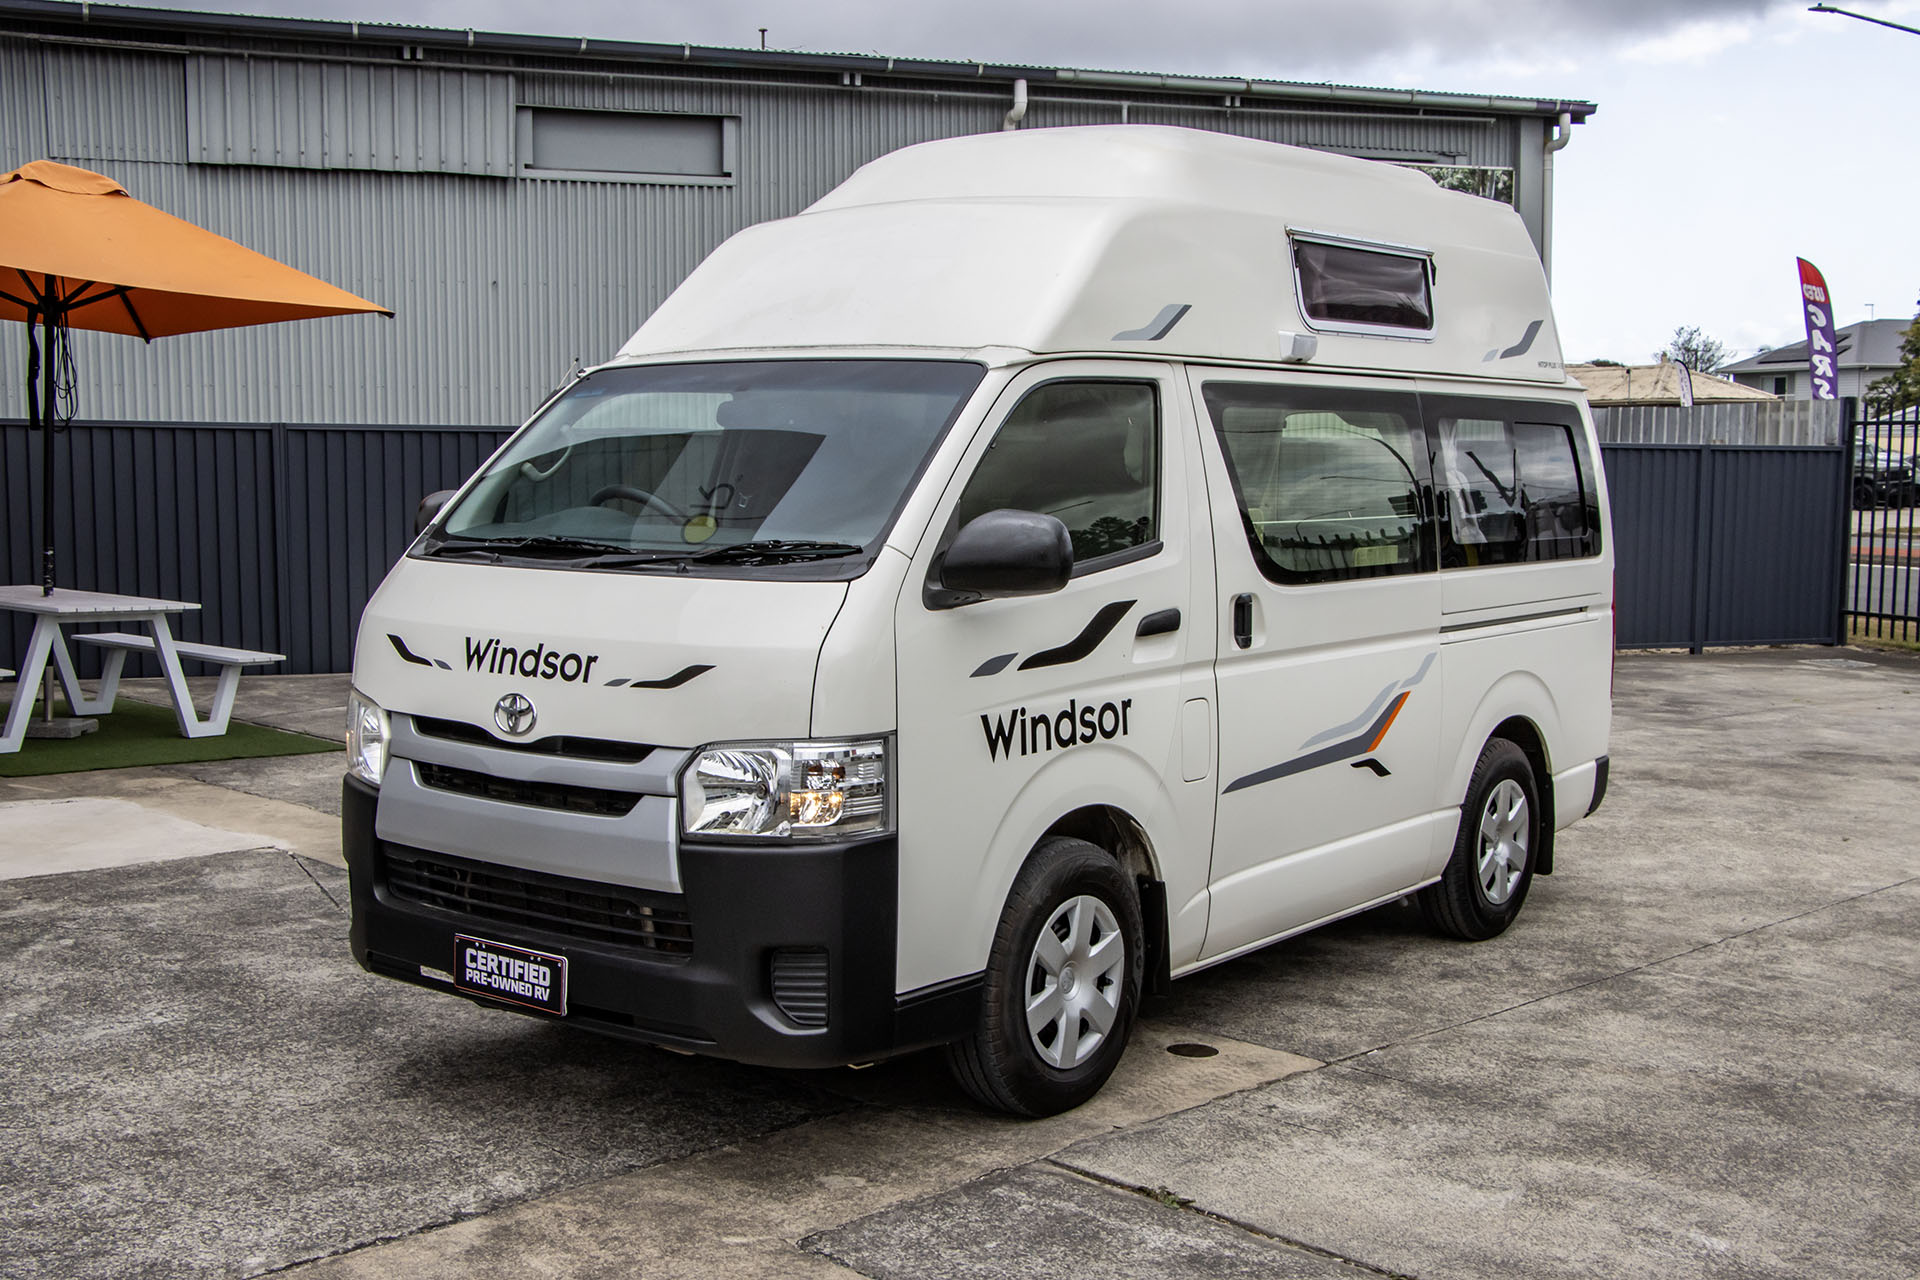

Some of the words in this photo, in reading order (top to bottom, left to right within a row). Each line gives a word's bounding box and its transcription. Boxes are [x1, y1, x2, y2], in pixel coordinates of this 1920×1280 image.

[465, 636, 599, 684] Windsor
[980, 698, 1132, 763] Windsor
[465, 948, 551, 987] CERTIFIED
[465, 968, 533, 997] PRE-OWNED
[534, 985, 551, 1002] RV
